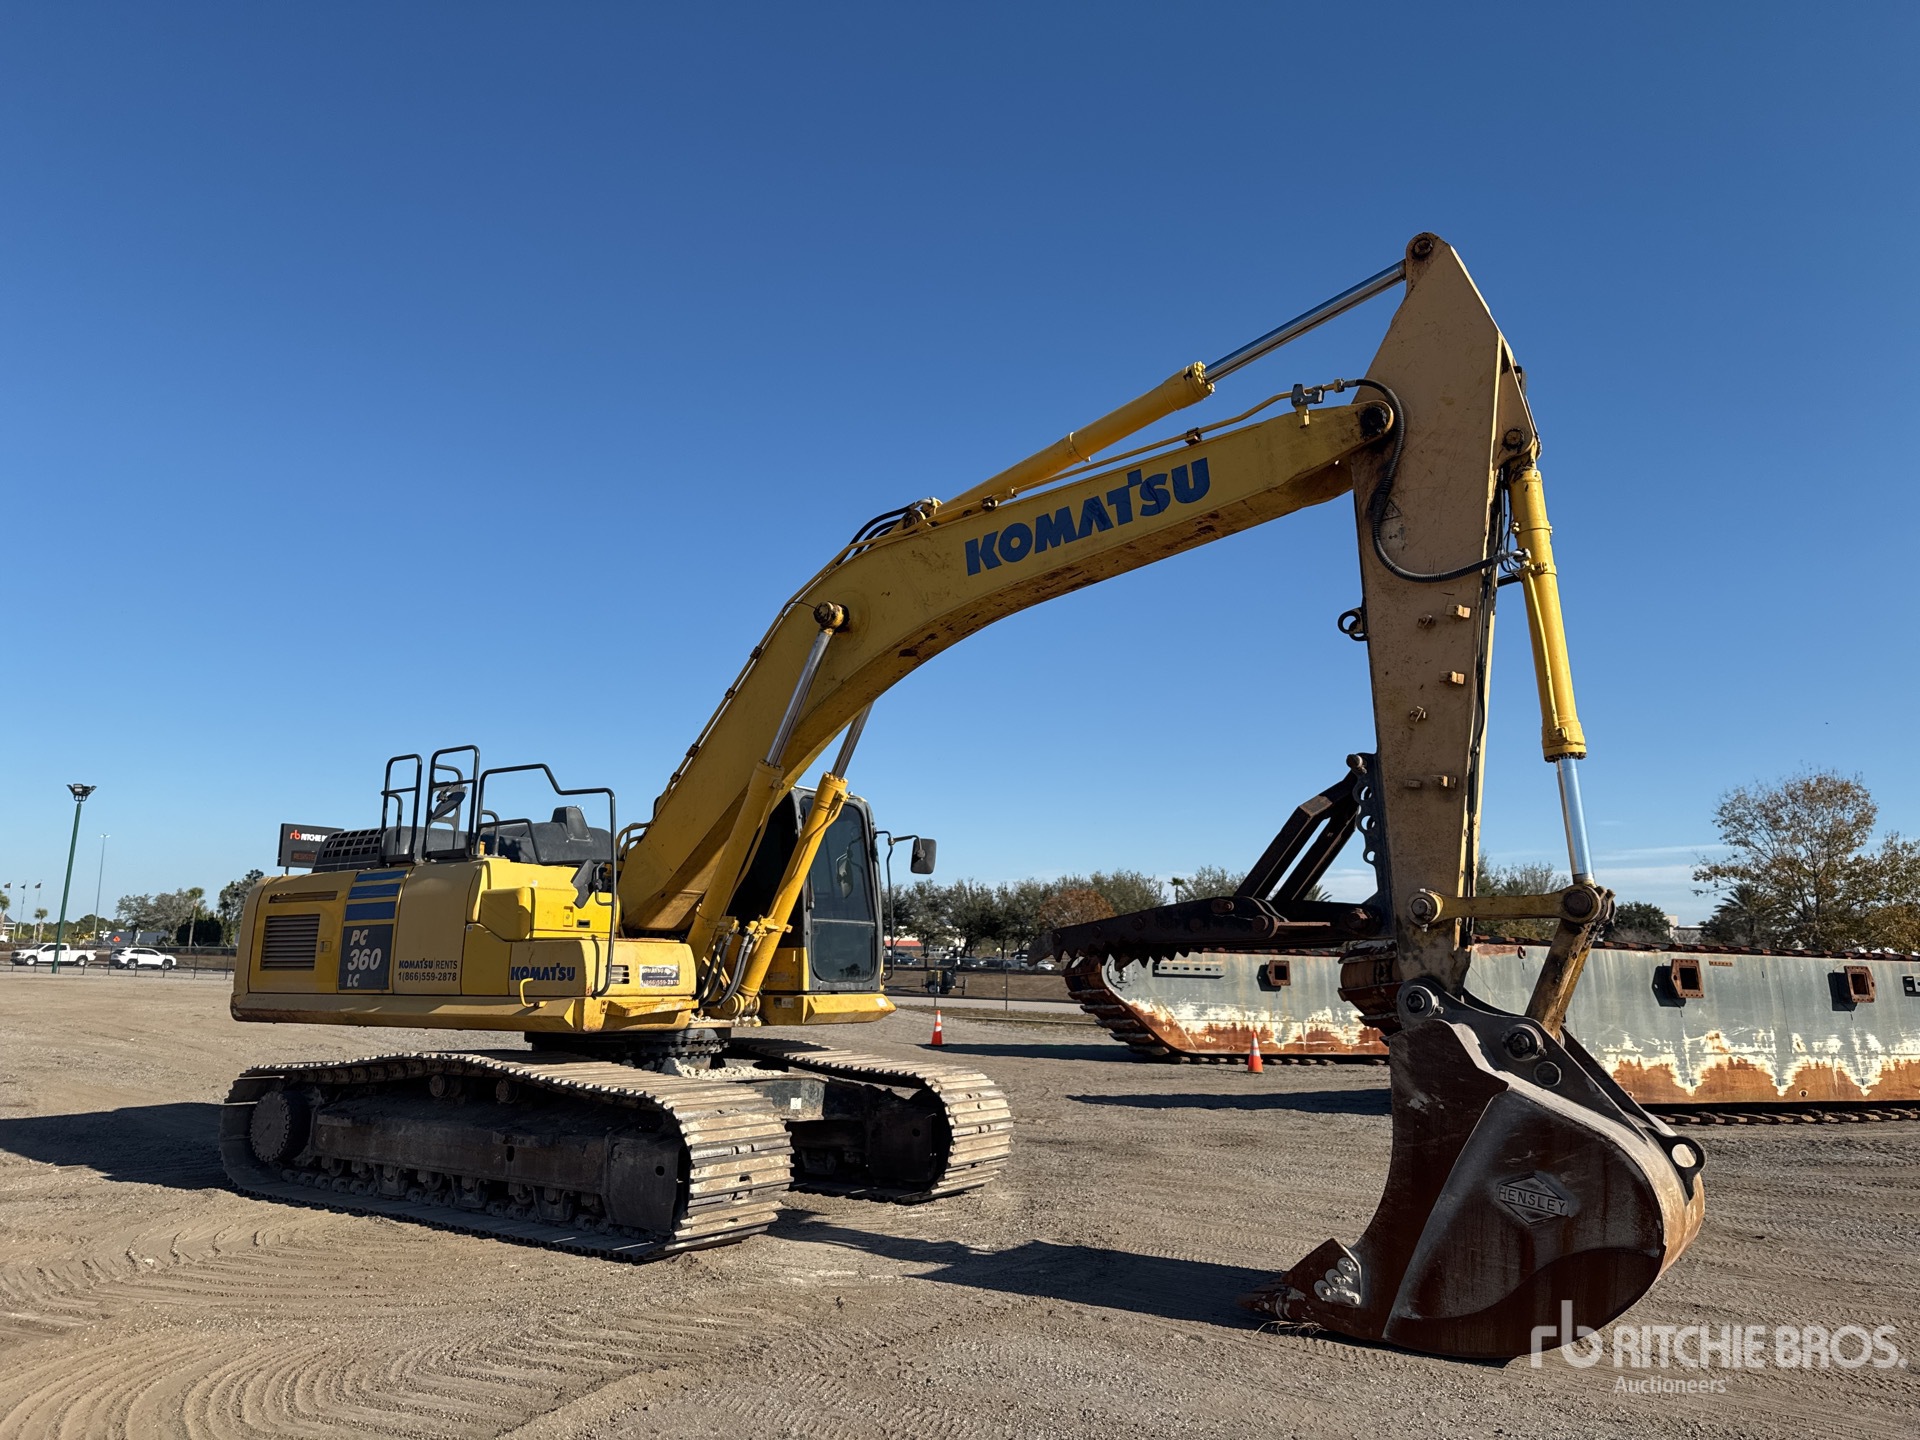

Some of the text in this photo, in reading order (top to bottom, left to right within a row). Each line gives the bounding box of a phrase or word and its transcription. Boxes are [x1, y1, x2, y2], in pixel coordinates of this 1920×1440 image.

[965, 457, 1211, 577] KOMATSU
[290, 829, 301, 840] rb
[350, 929, 369, 946] PC
[347, 948, 382, 971] 360
[399, 958, 458, 970] KOMATSU RENTS
[346, 973, 360, 987] LC
[398, 971, 457, 983] 1(866)559-2878
[510, 962, 576, 982] KOMATSU
[1498, 1185, 1566, 1214] HENSLEY
